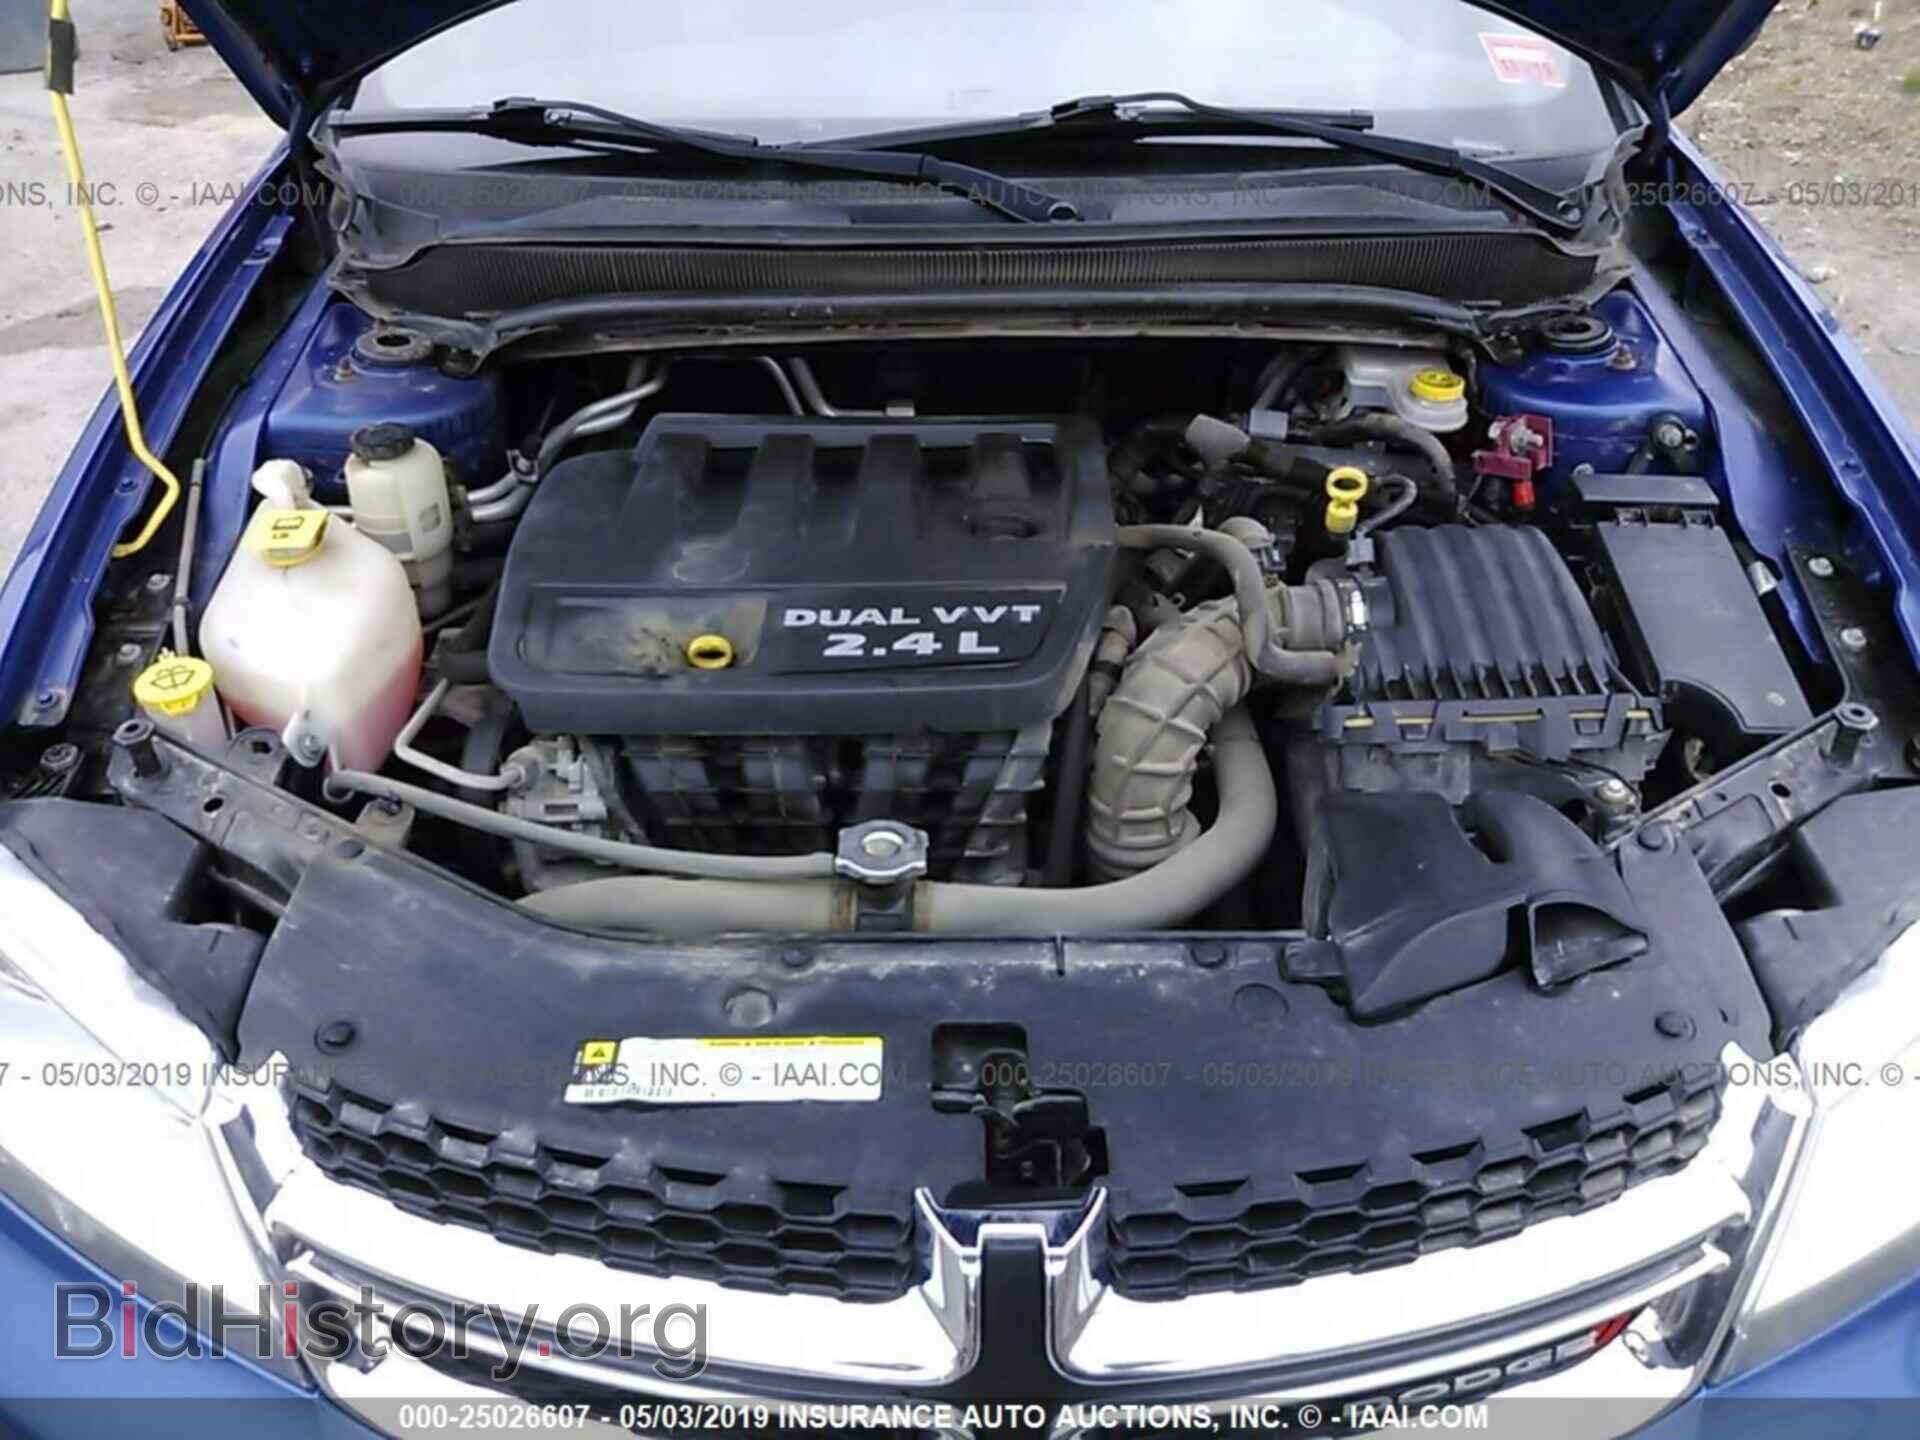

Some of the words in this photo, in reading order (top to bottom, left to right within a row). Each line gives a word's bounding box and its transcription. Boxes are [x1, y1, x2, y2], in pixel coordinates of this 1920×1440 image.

[784, 608, 920, 627] DUAL
[934, 605, 1041, 624] VVT
[823, 631, 942, 656] 2.4
[958, 631, 1000, 654] L
